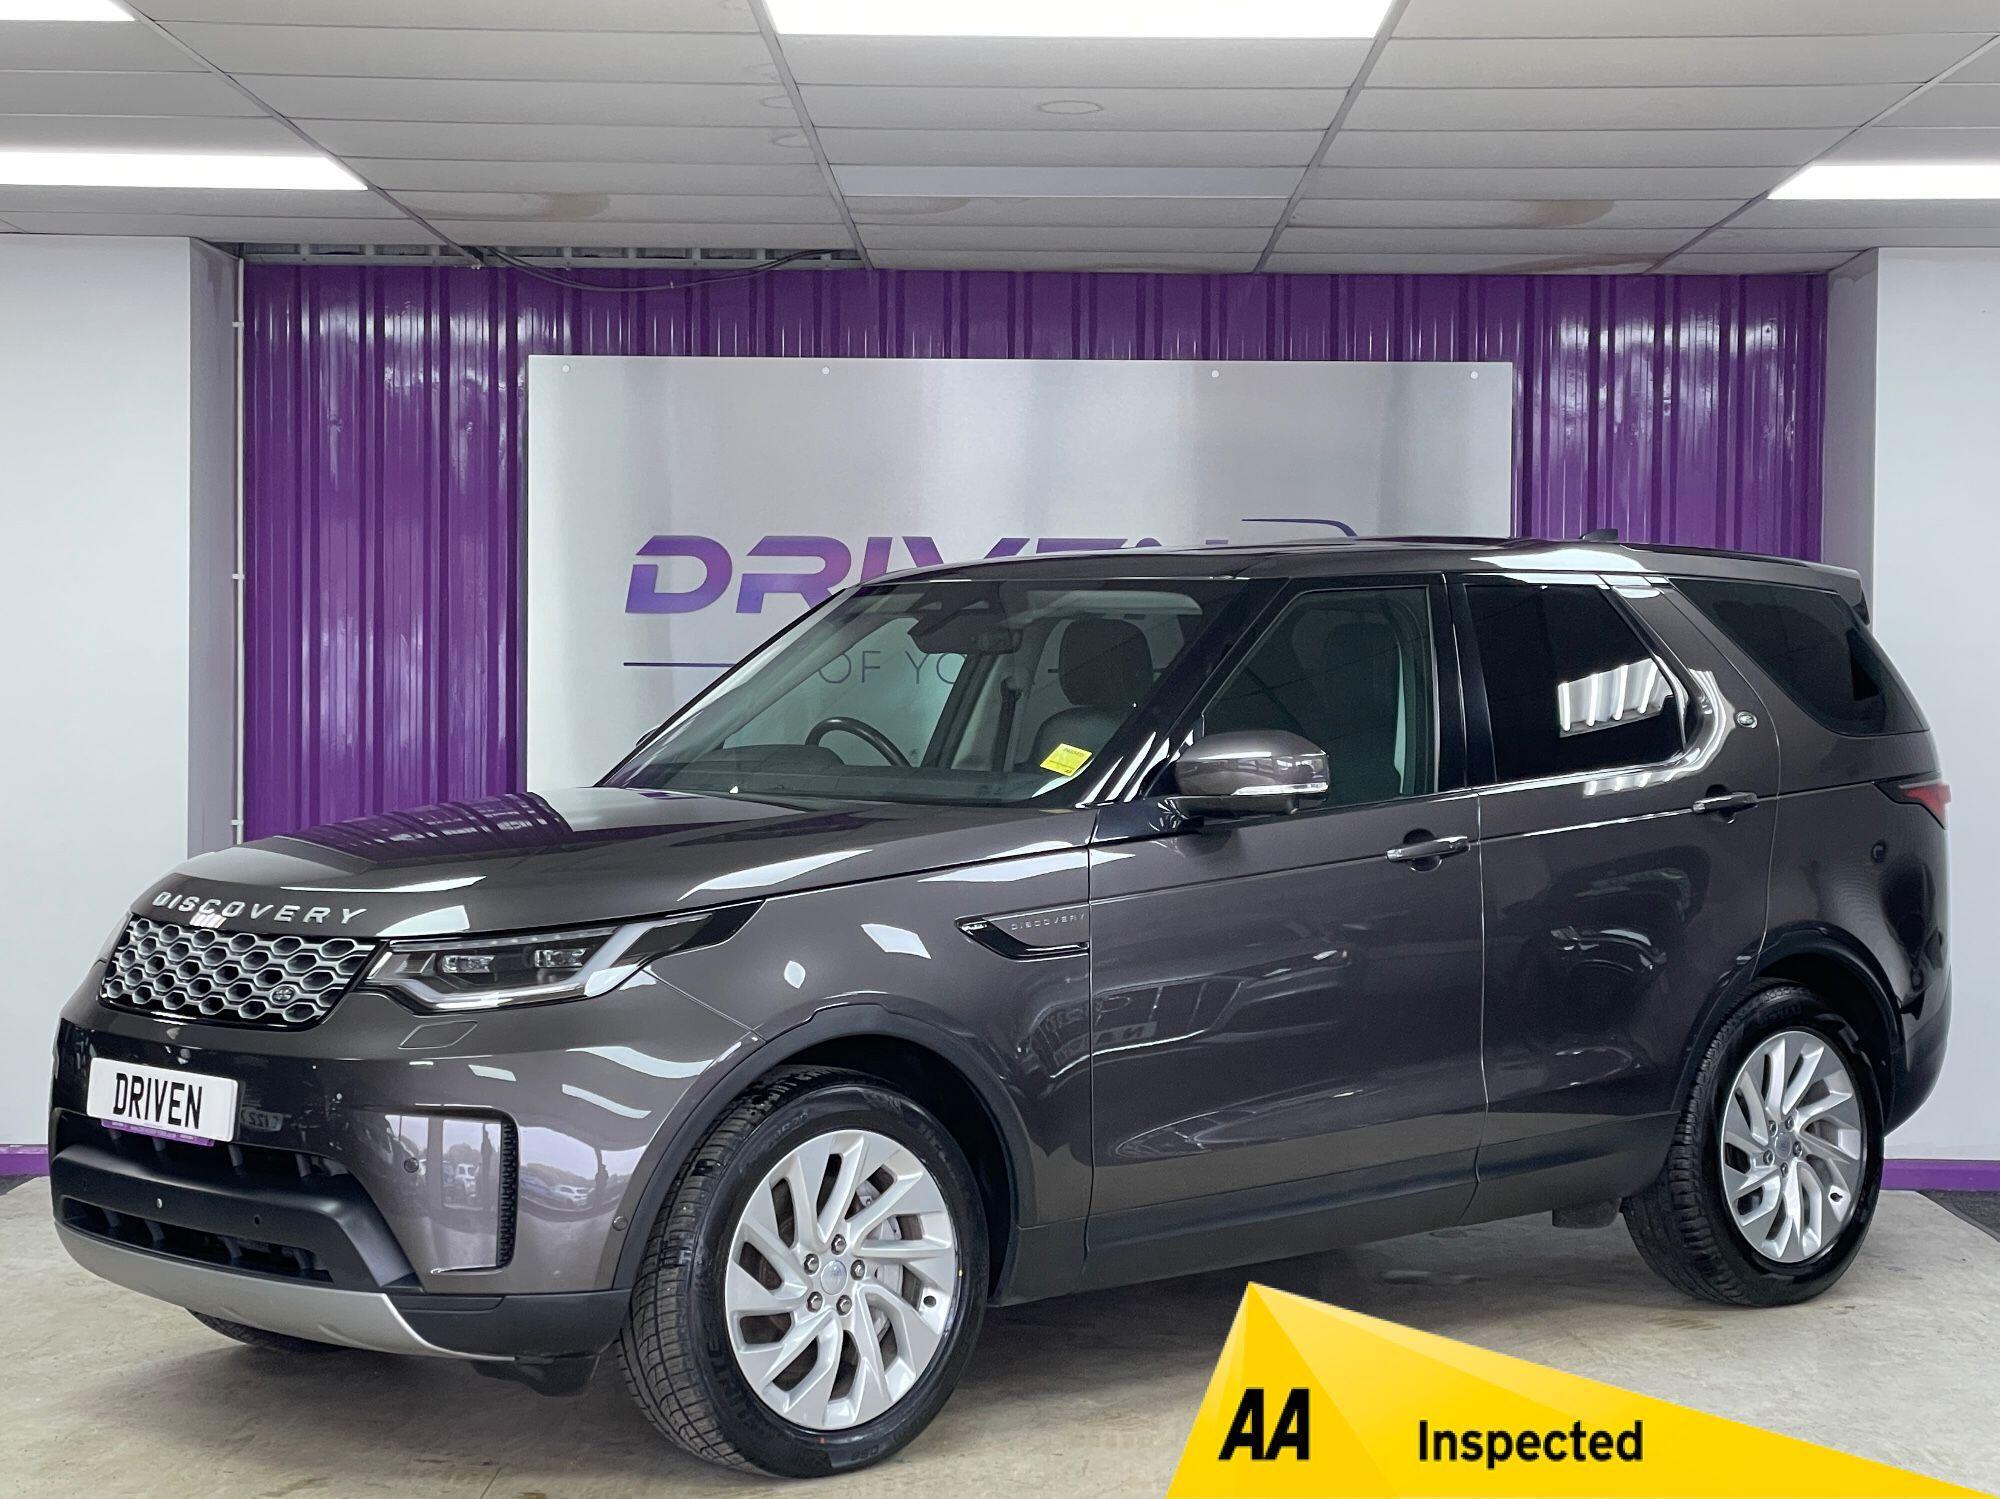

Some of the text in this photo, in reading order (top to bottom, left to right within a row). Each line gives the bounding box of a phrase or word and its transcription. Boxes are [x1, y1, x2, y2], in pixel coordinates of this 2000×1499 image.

[818, 650, 967, 685] OF YO
[152, 891, 367, 924] DISCOVERY
[1011, 914, 1085, 930] DISCOVERY
[113, 1072, 202, 1130] DRIVEN
